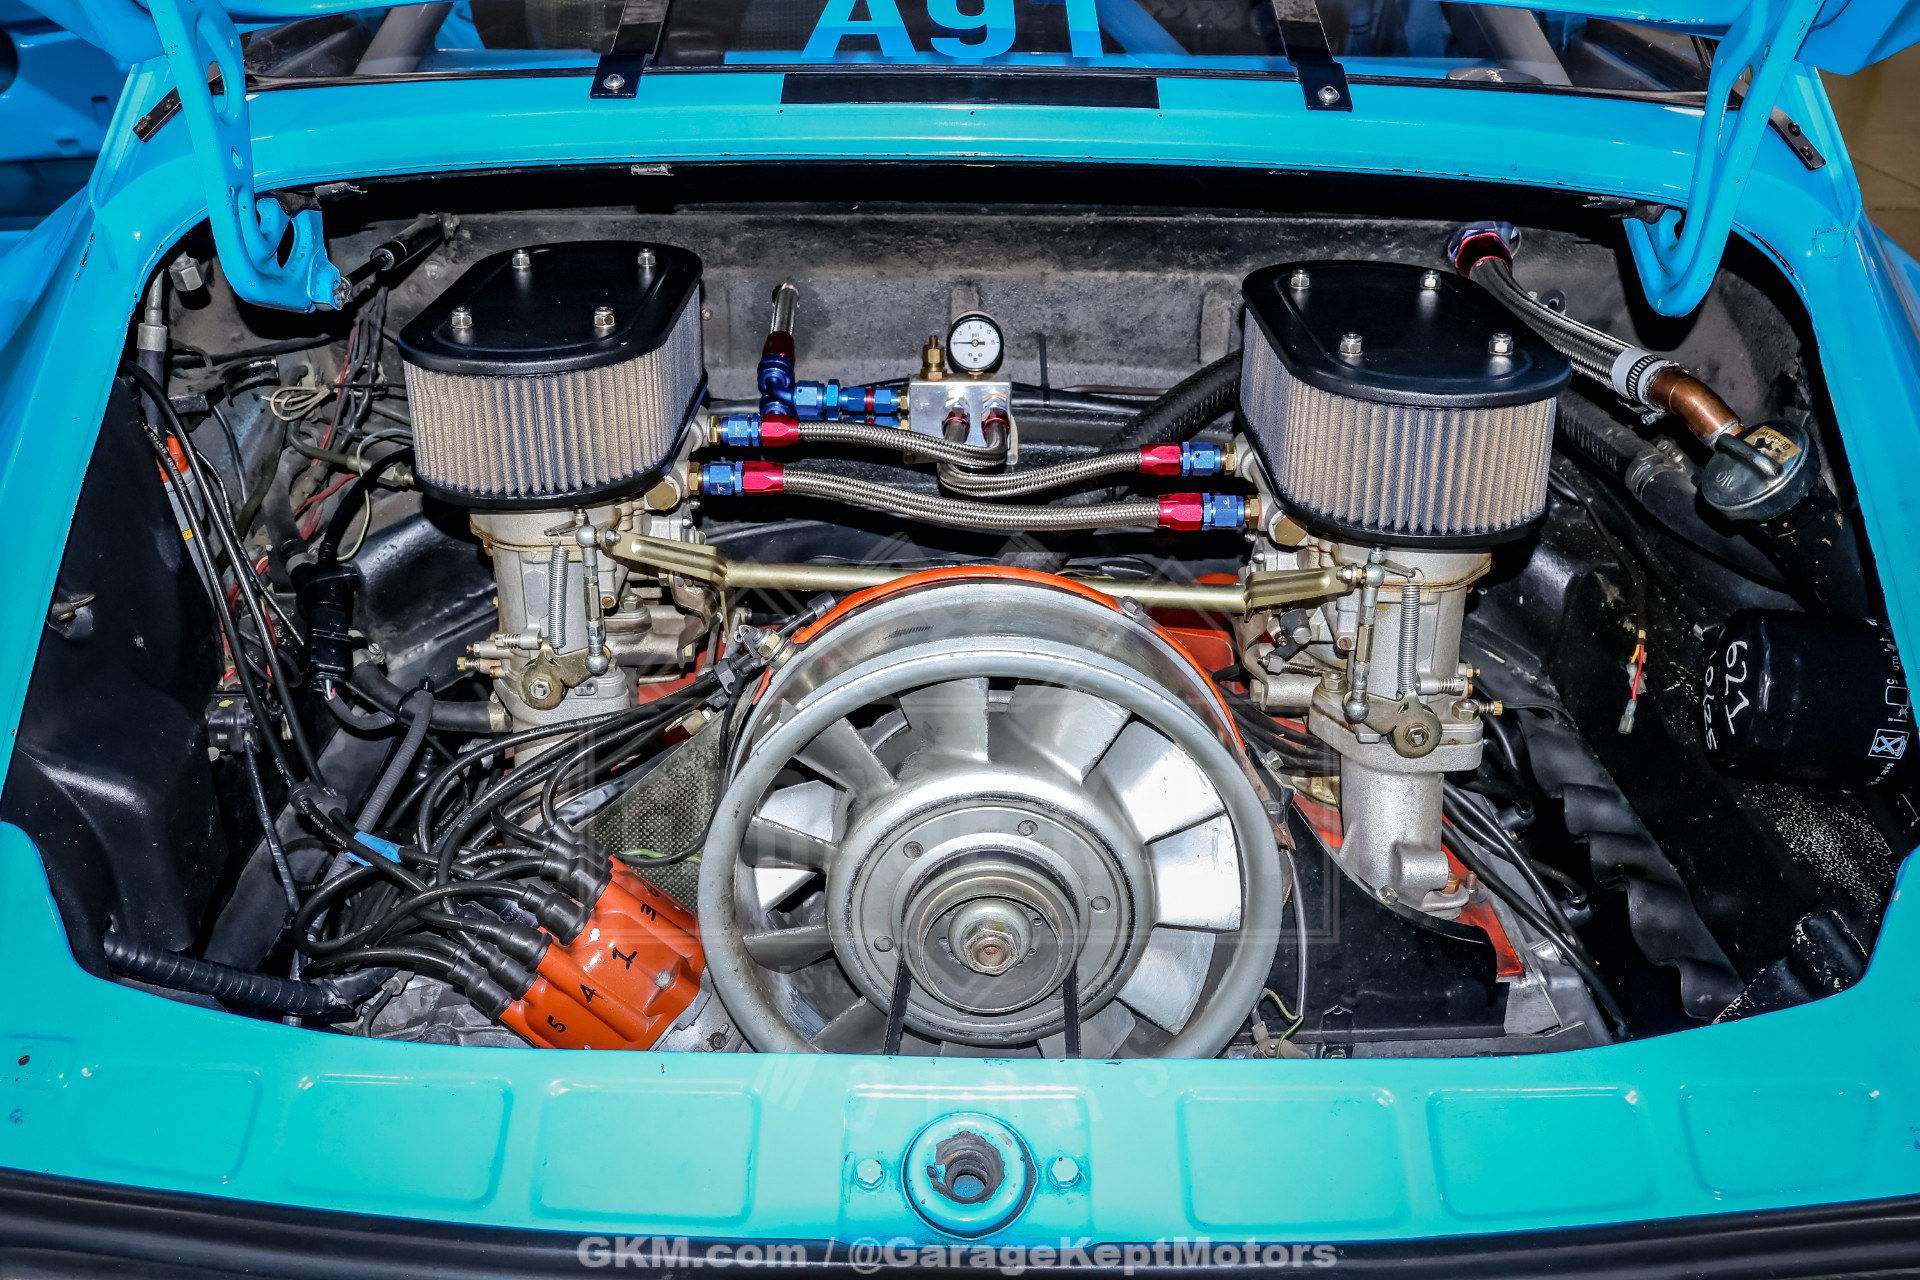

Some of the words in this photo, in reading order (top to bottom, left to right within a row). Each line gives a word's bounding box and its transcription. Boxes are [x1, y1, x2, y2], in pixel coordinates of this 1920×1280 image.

[480, 848, 507, 859] MOTOR
[640, 902, 657, 922] 3
[612, 946, 638, 970] 1
[580, 983, 600, 1003] 4
[547, 1015, 567, 1033] 5
